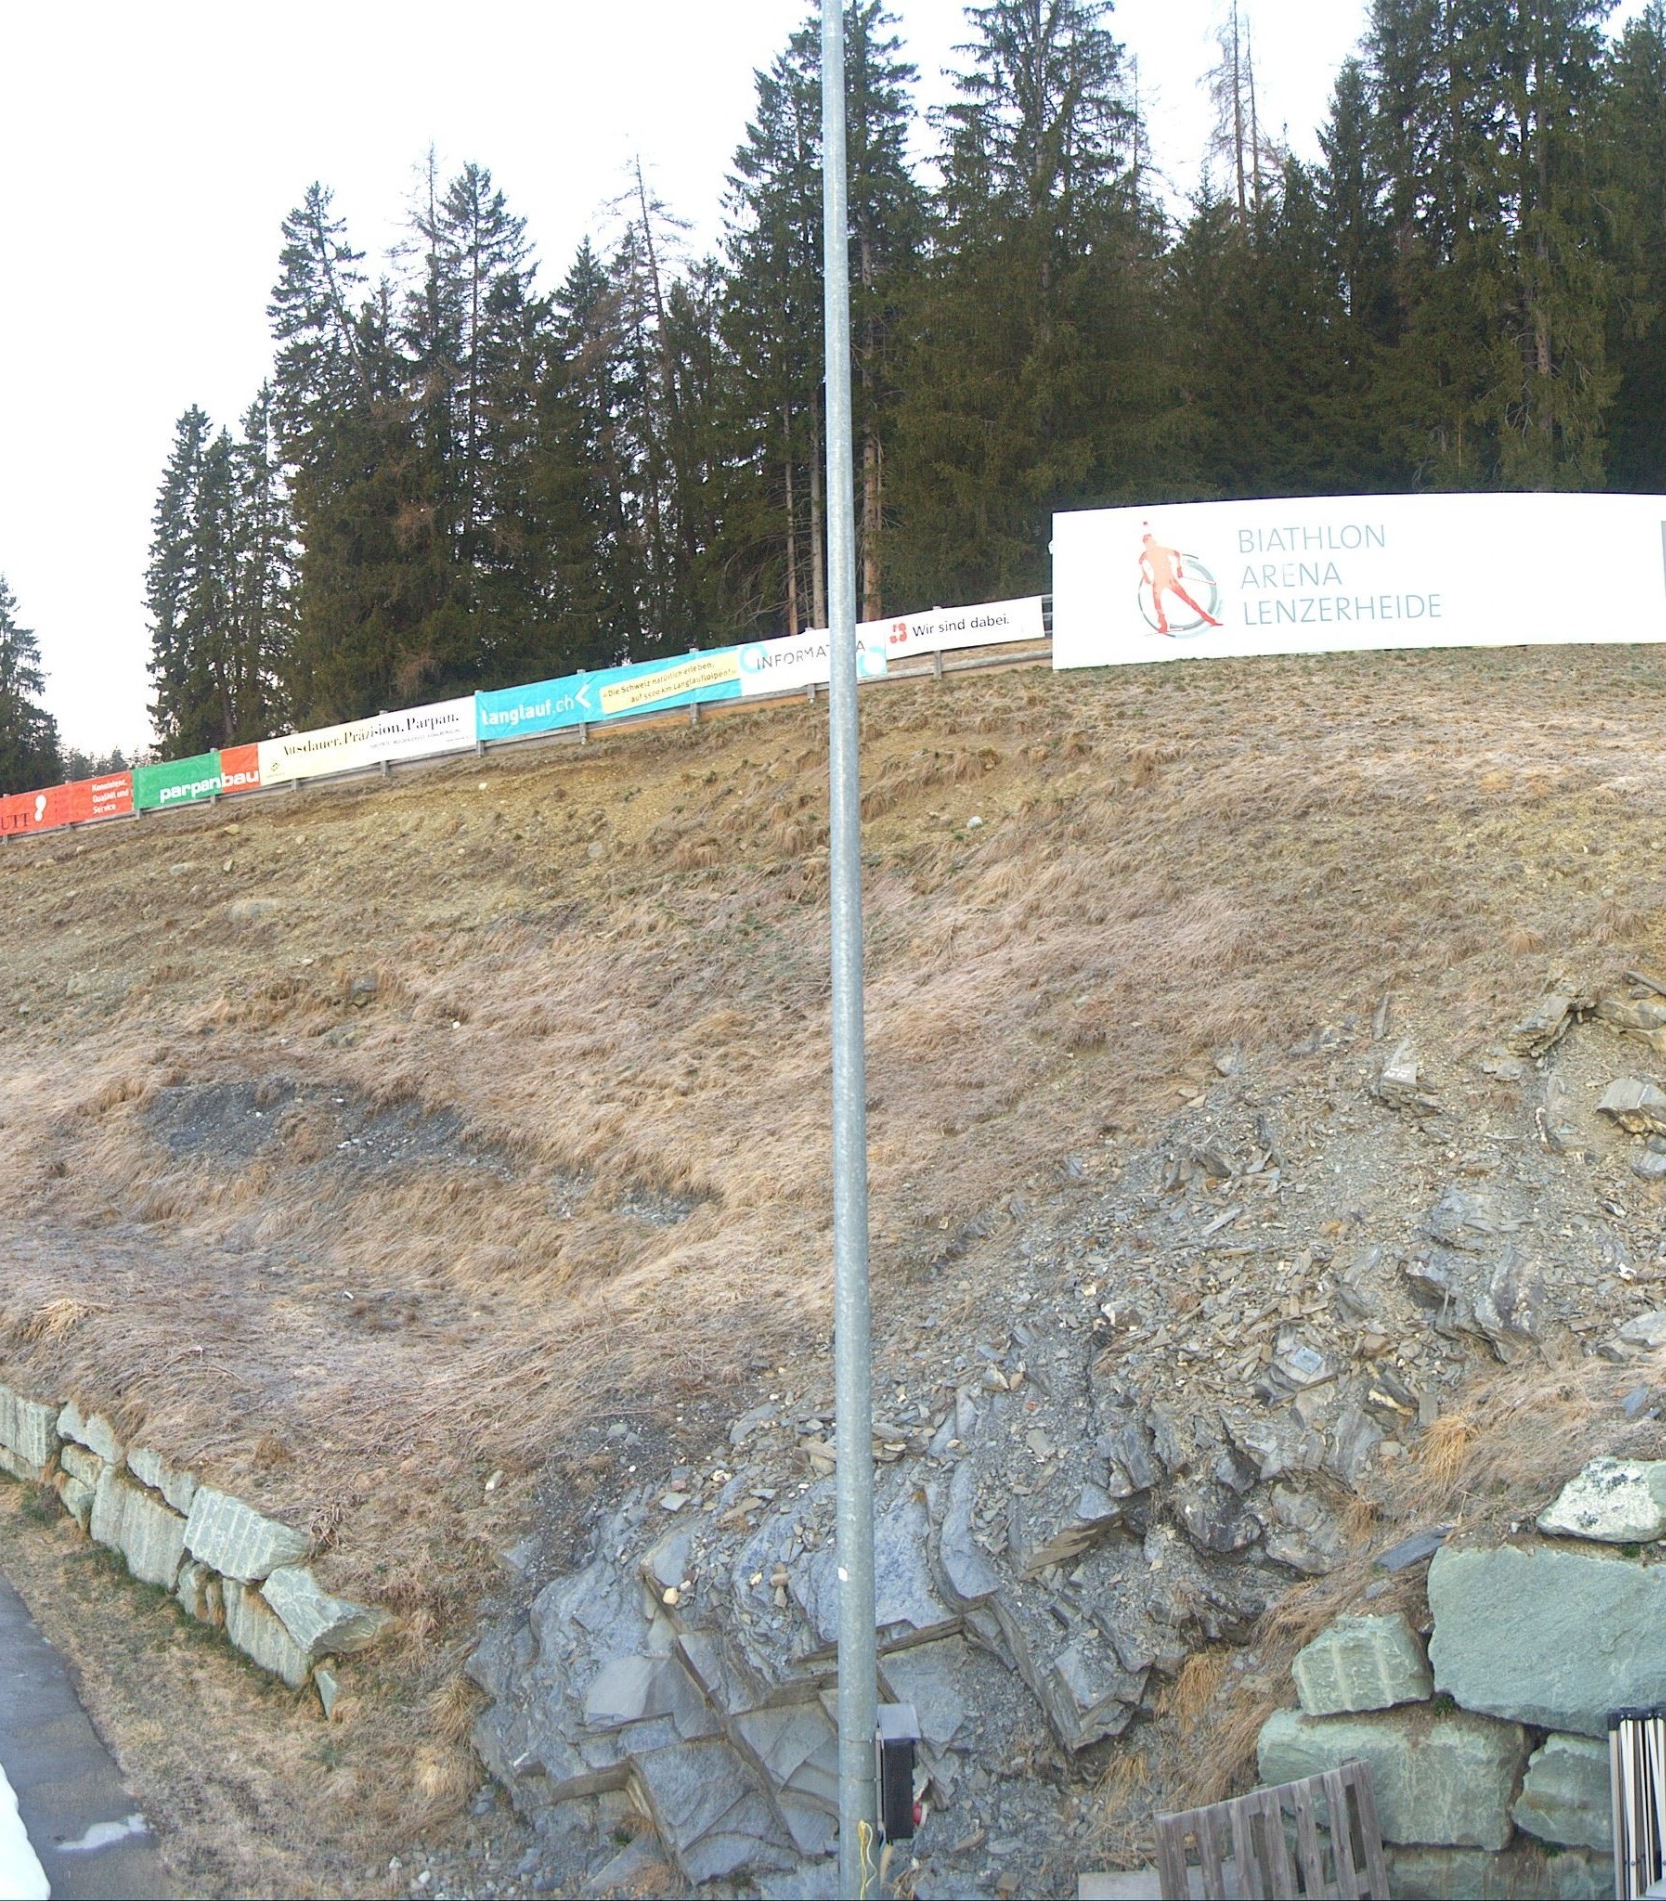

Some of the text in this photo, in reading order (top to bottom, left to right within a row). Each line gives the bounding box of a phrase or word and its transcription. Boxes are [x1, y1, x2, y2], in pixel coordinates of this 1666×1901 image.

[1238, 524, 1386, 554] BIATHLON
[1240, 562, 1343, 590] ARENA
[1243, 593, 1442, 627] LENZERHEIDE
[912, 613, 1010, 637] Wir sind dabei.
[621, 680, 651, 695] Schweiz
[652, 669, 683, 686] natürlich
[481, 694, 574, 727] langlauf.ch
[159, 770, 259, 803] parpanbau
[93, 803, 117, 814] Service
